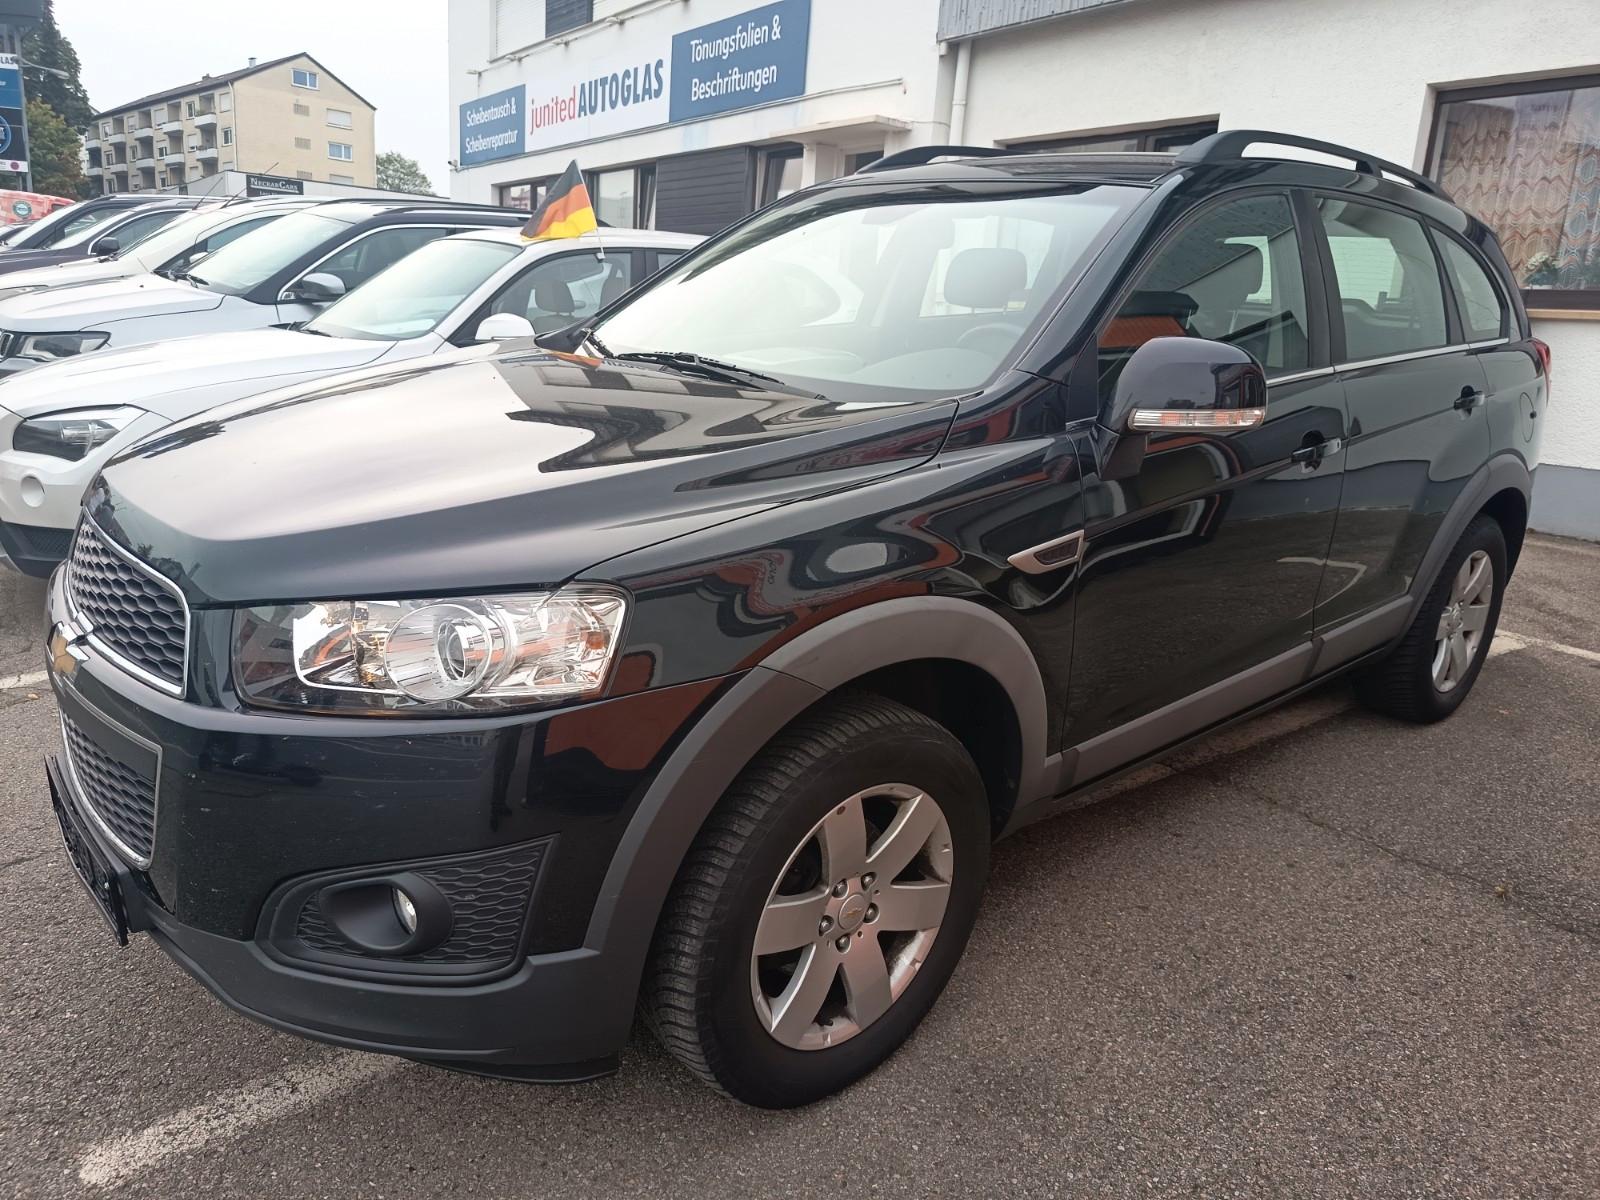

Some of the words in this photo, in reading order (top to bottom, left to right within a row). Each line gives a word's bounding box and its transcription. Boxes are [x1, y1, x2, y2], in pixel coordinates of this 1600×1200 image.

[690, 22, 769, 63] Tönungsfolien
[771, 14, 781, 41] &
[691, 64, 778, 101] Beschriftungen
[466, 97, 511, 128] Scheibentausch
[511, 96, 517, 115] &
[465, 129, 518, 154] Scheibenreparatur
